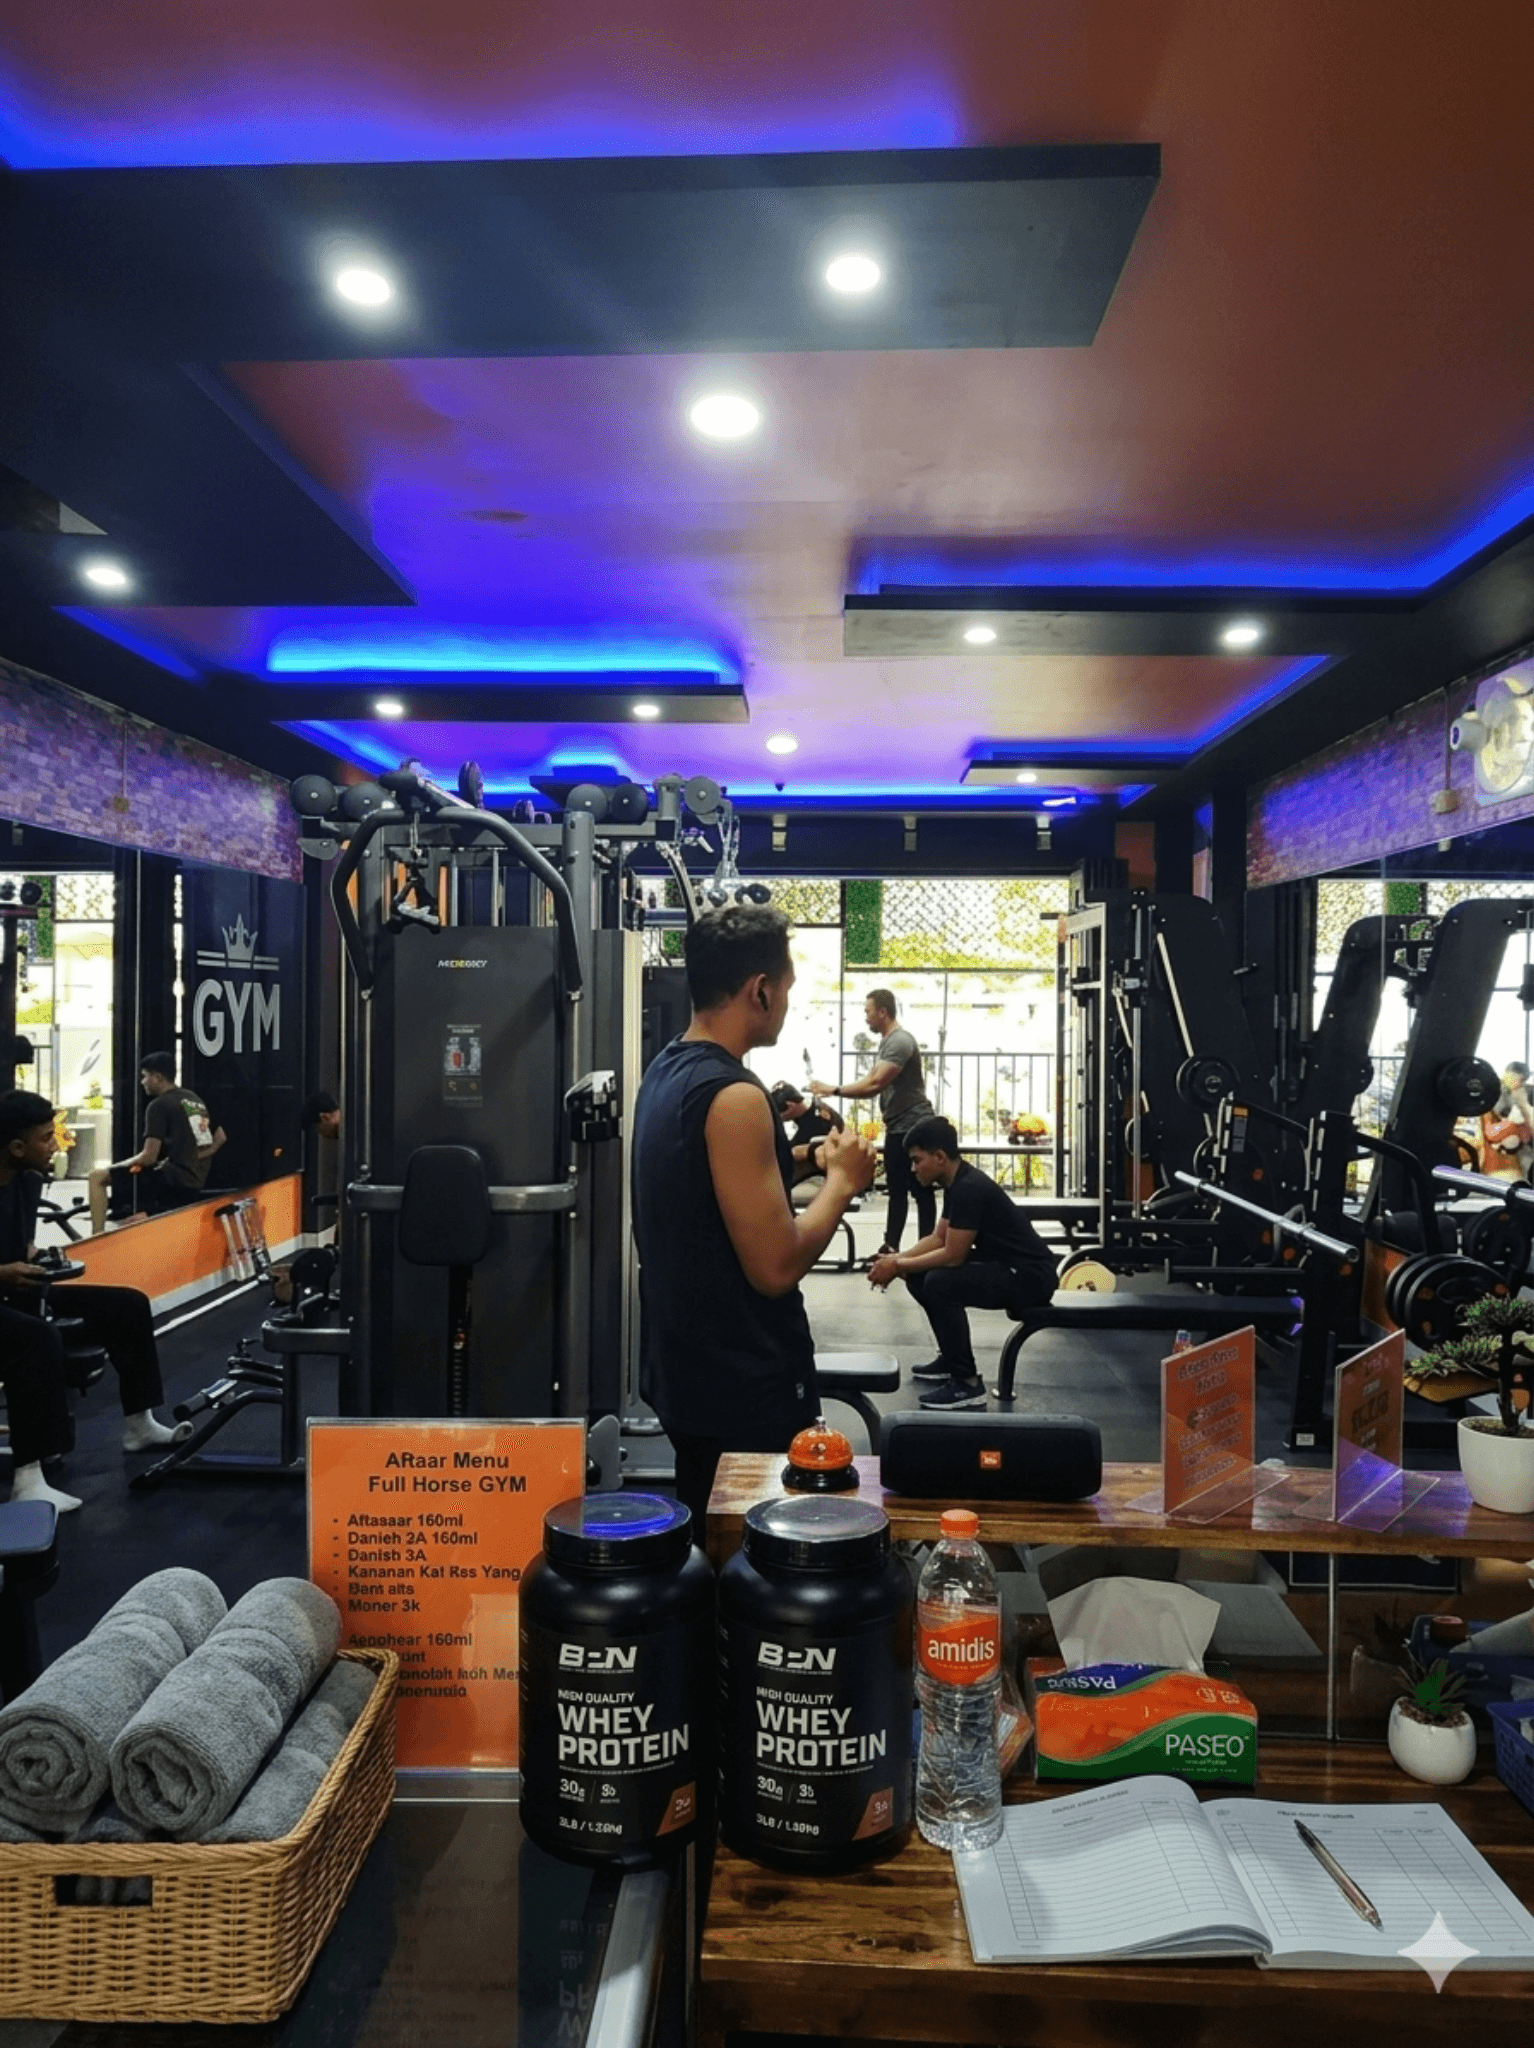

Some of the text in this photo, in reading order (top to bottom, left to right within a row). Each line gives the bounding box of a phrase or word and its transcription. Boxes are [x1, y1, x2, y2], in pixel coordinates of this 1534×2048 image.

[193, 978, 280, 1057] GYM
[453, 1452, 509, 1468] Menu
[369, 1476, 527, 1492] Full Horse GYM
[418, 1514, 463, 1527] 160ml
[406, 1532, 427, 1544] 2A
[432, 1532, 478, 1544] 160ml
[349, 1550, 427, 1561] Danish 3A
[482, 1565, 521, 1581] Yang
[428, 1633, 473, 1646] 160ml
[928, 1637, 995, 1662] amidis
[585, 1692, 635, 1704] QUALITY
[784, 1691, 834, 1704] QUALITY
[558, 1703, 654, 1734] WHEY
[756, 1700, 852, 1735] WHEY
[559, 1723, 689, 1766] PROTEIN
[757, 1729, 886, 1766] PROTEIN
[1165, 1734, 1245, 1757] PASEO
